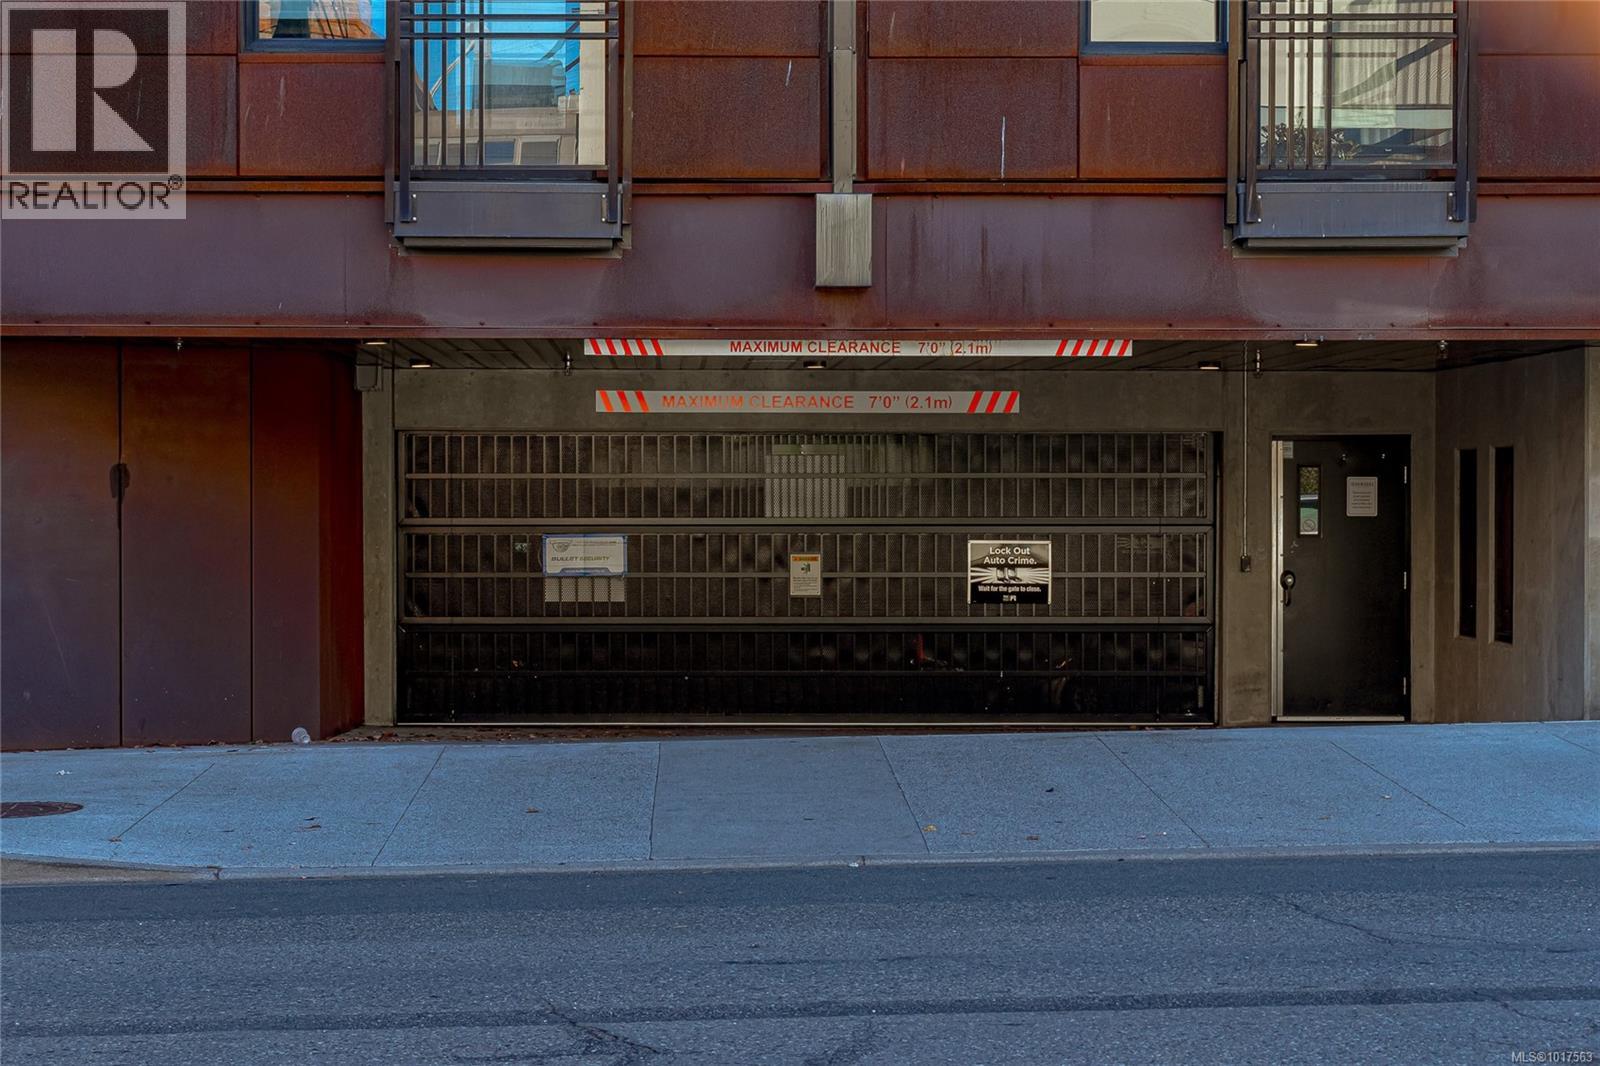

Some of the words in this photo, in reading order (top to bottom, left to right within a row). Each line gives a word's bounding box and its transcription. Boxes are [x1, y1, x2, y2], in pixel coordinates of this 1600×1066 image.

[730, 340, 802, 353] MAXIMUM
[807, 341, 901, 354] CLEARANCE
[950, 340, 993, 355] (2.1m)
[662, 395, 744, 408] MAXIMUM
[748, 395, 854, 409] CLEARANCE
[905, 395, 952, 410] (2.1m)
[989, 546, 1011, 555] Lock
[1013, 546, 1031, 555] Out
[983, 556, 1006, 565] Auto
[1007, 556, 1038, 565] Crime.
